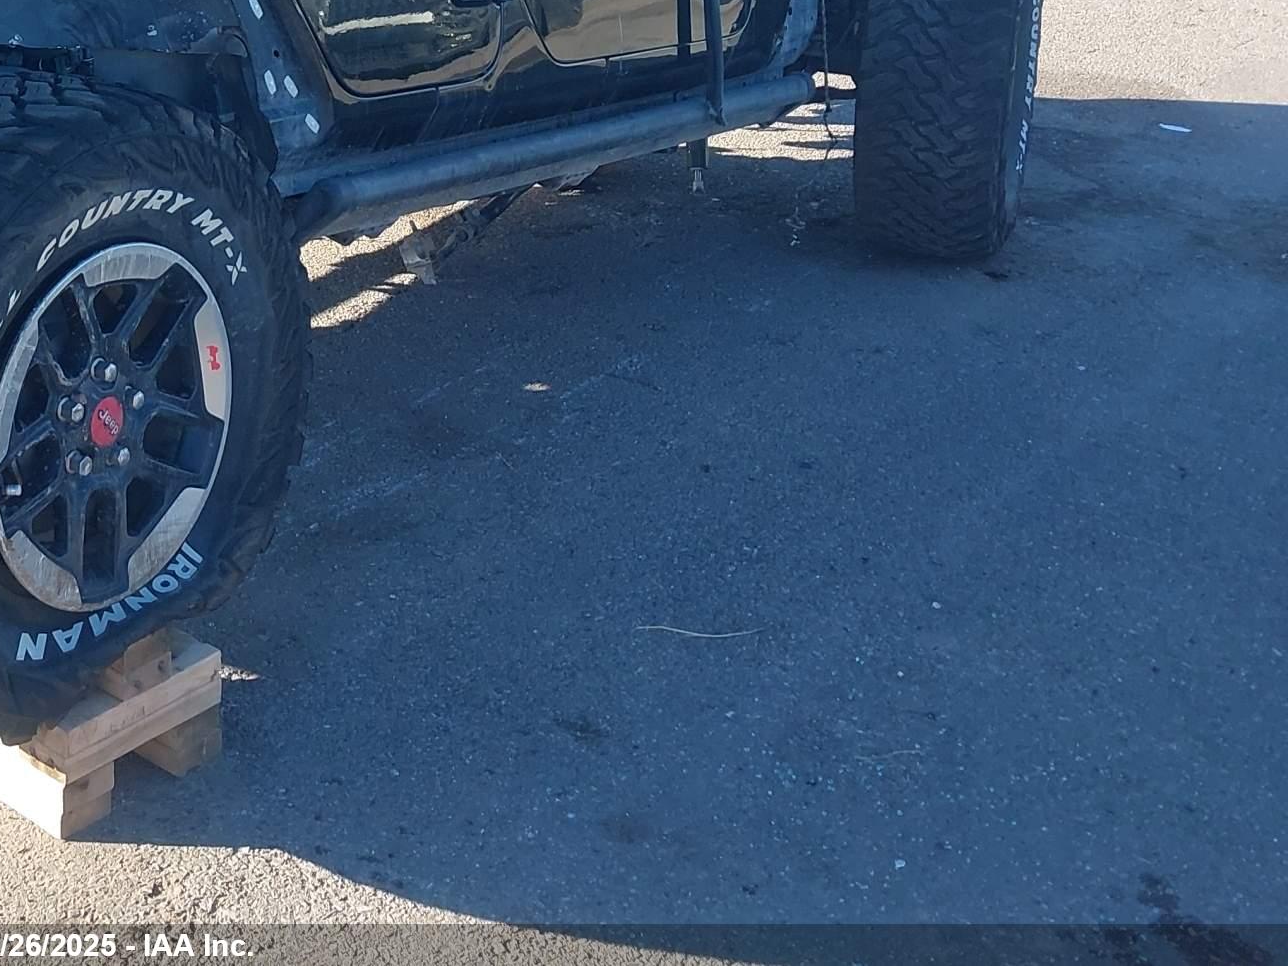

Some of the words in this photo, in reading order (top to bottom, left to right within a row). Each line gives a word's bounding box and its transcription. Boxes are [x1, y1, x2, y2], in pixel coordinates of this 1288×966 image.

[36, 189, 194, 272] COUNTRY
[191, 208, 248, 286] MT-X
[98, 409, 119, 435] Jeep
[15, 543, 204, 661] IRONMAN
